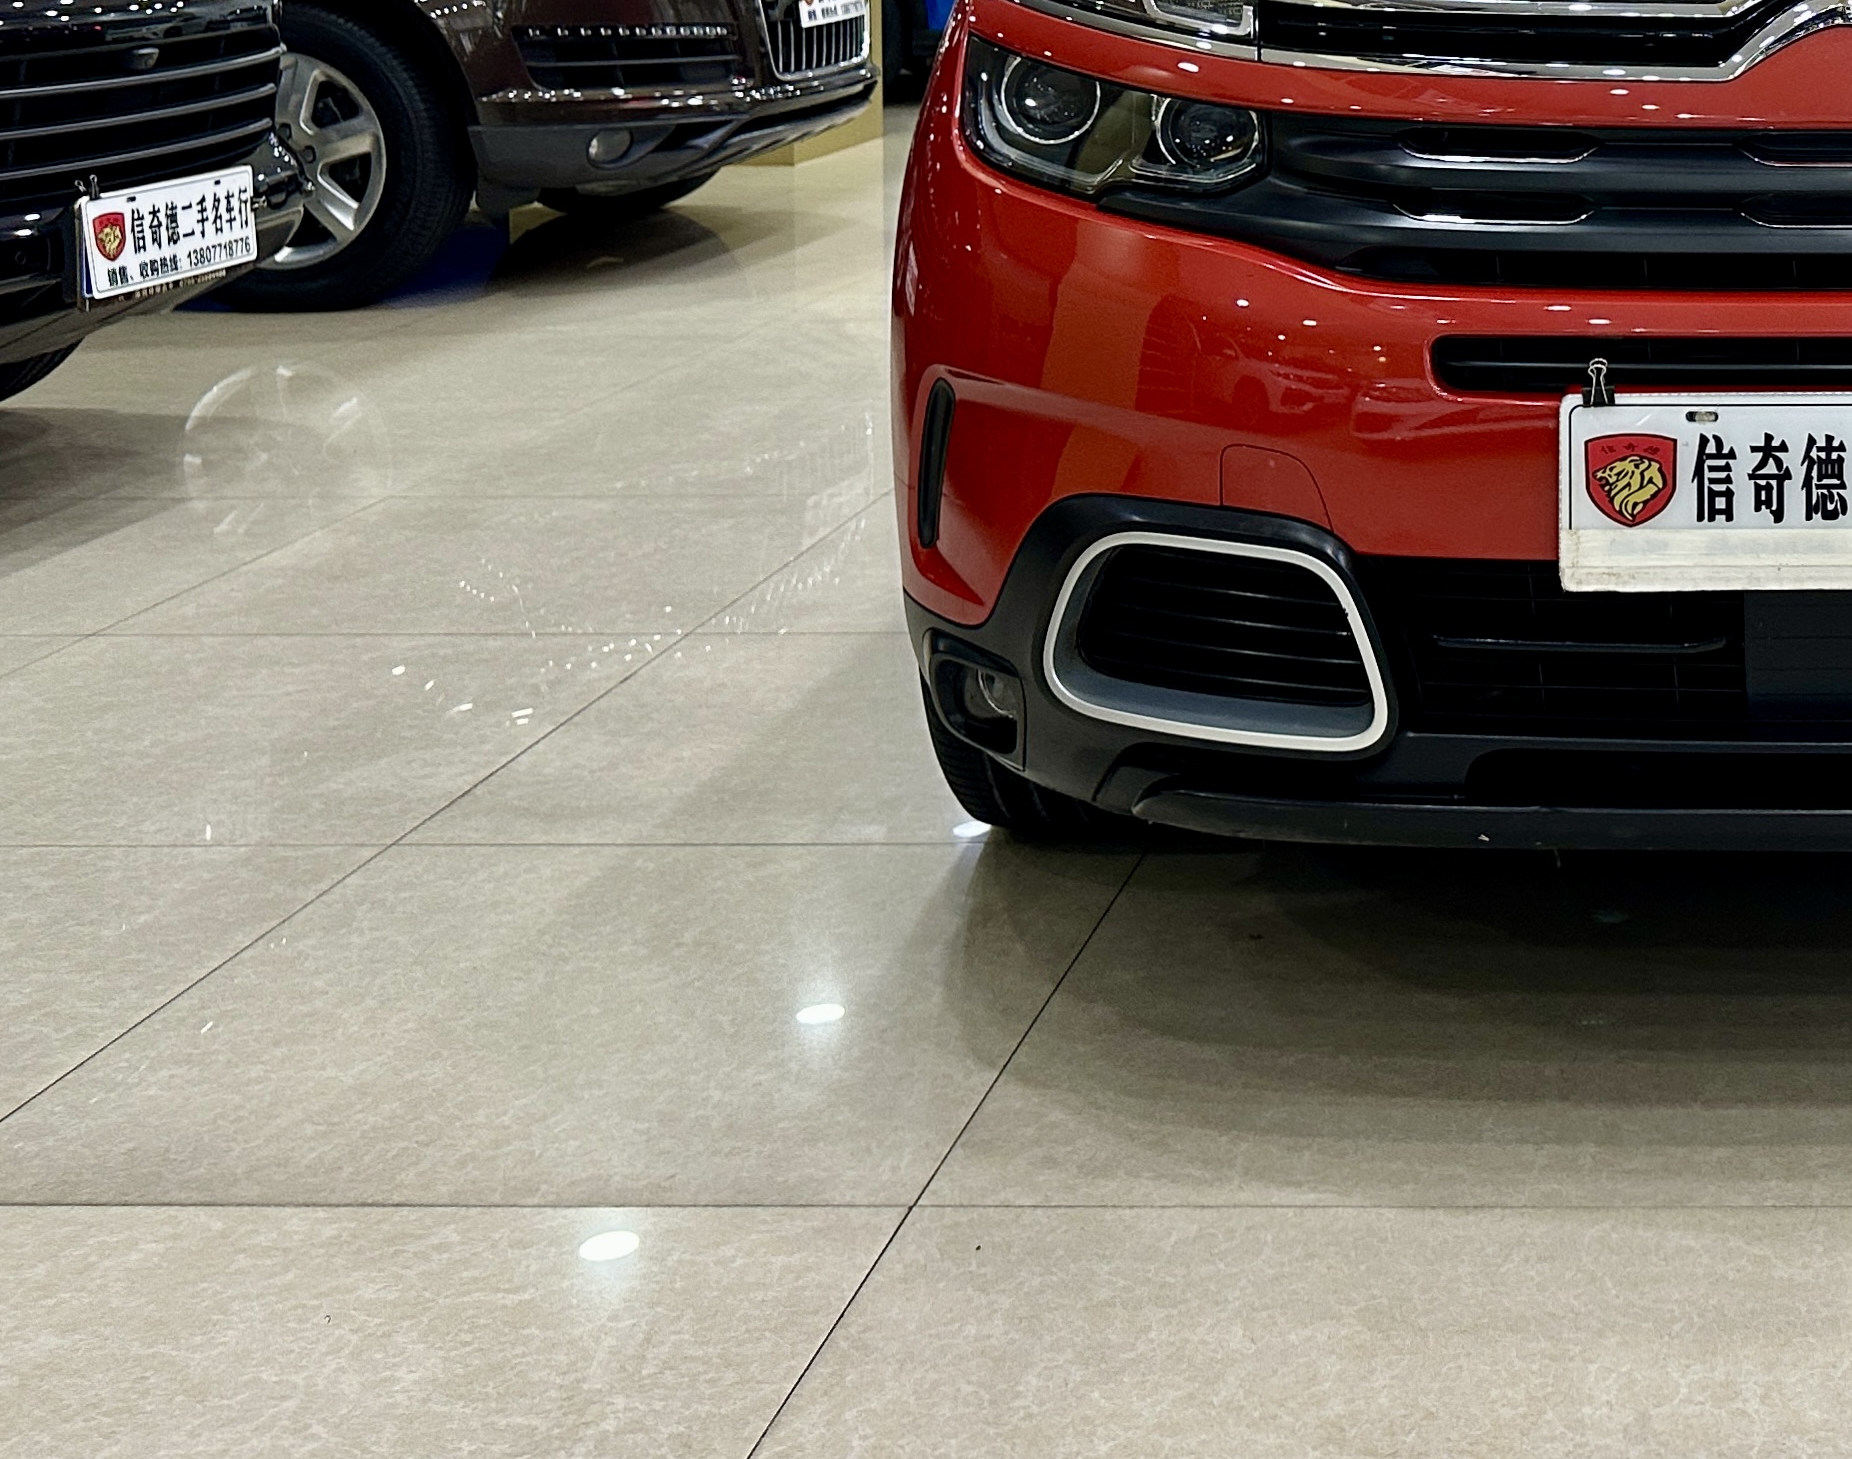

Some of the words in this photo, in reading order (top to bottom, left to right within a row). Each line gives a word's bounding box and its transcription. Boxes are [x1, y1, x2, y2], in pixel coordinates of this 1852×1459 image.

[130, 185, 250, 254] 信奇德二手名车行
[187, 236, 251, 268] 13807718776
